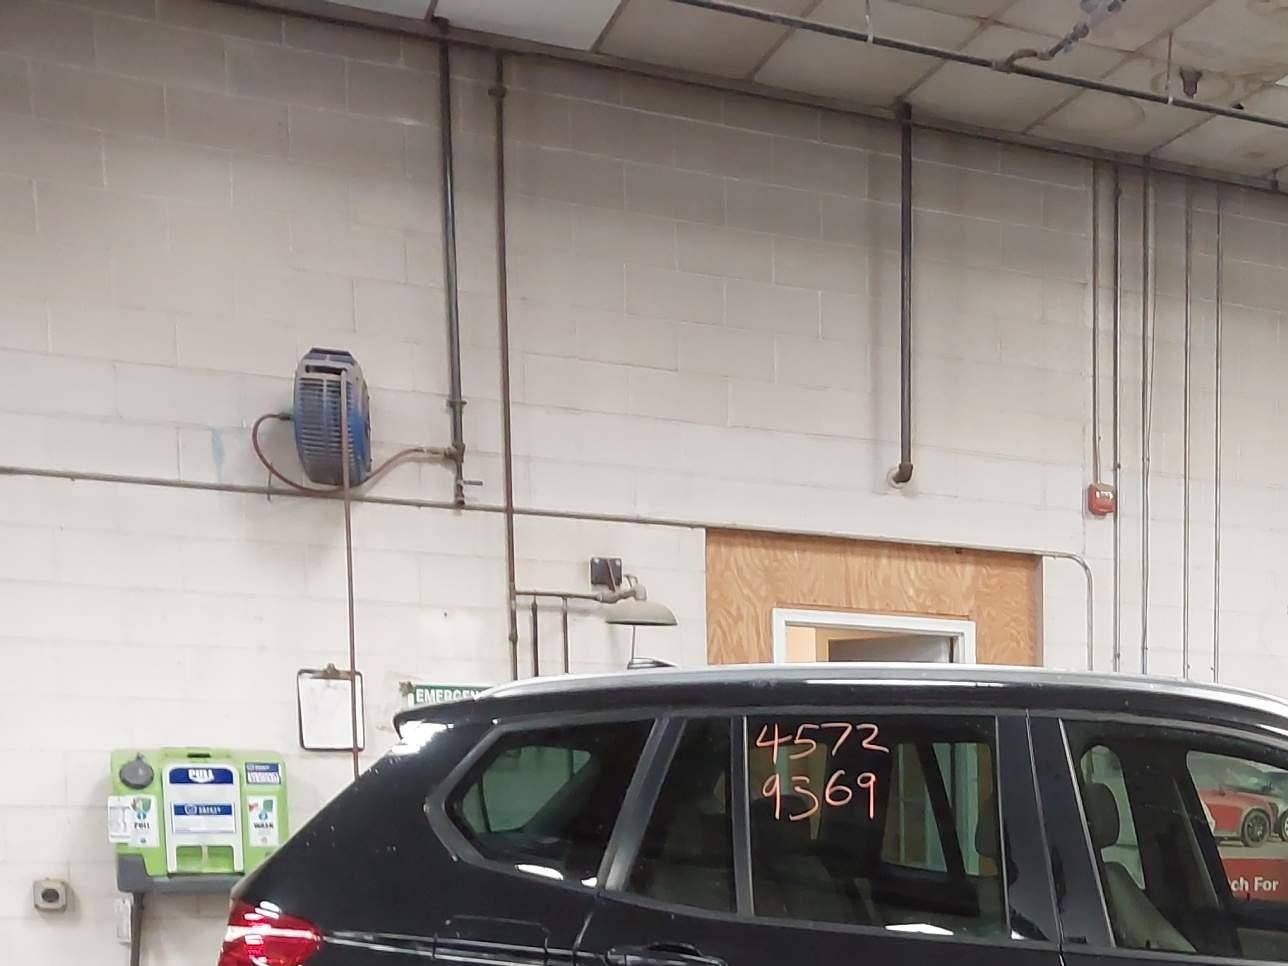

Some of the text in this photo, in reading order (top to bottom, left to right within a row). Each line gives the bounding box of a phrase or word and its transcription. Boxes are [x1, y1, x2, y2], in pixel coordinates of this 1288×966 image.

[755, 722, 890, 765] 4572
[1229, 876, 1279, 892] ch For
